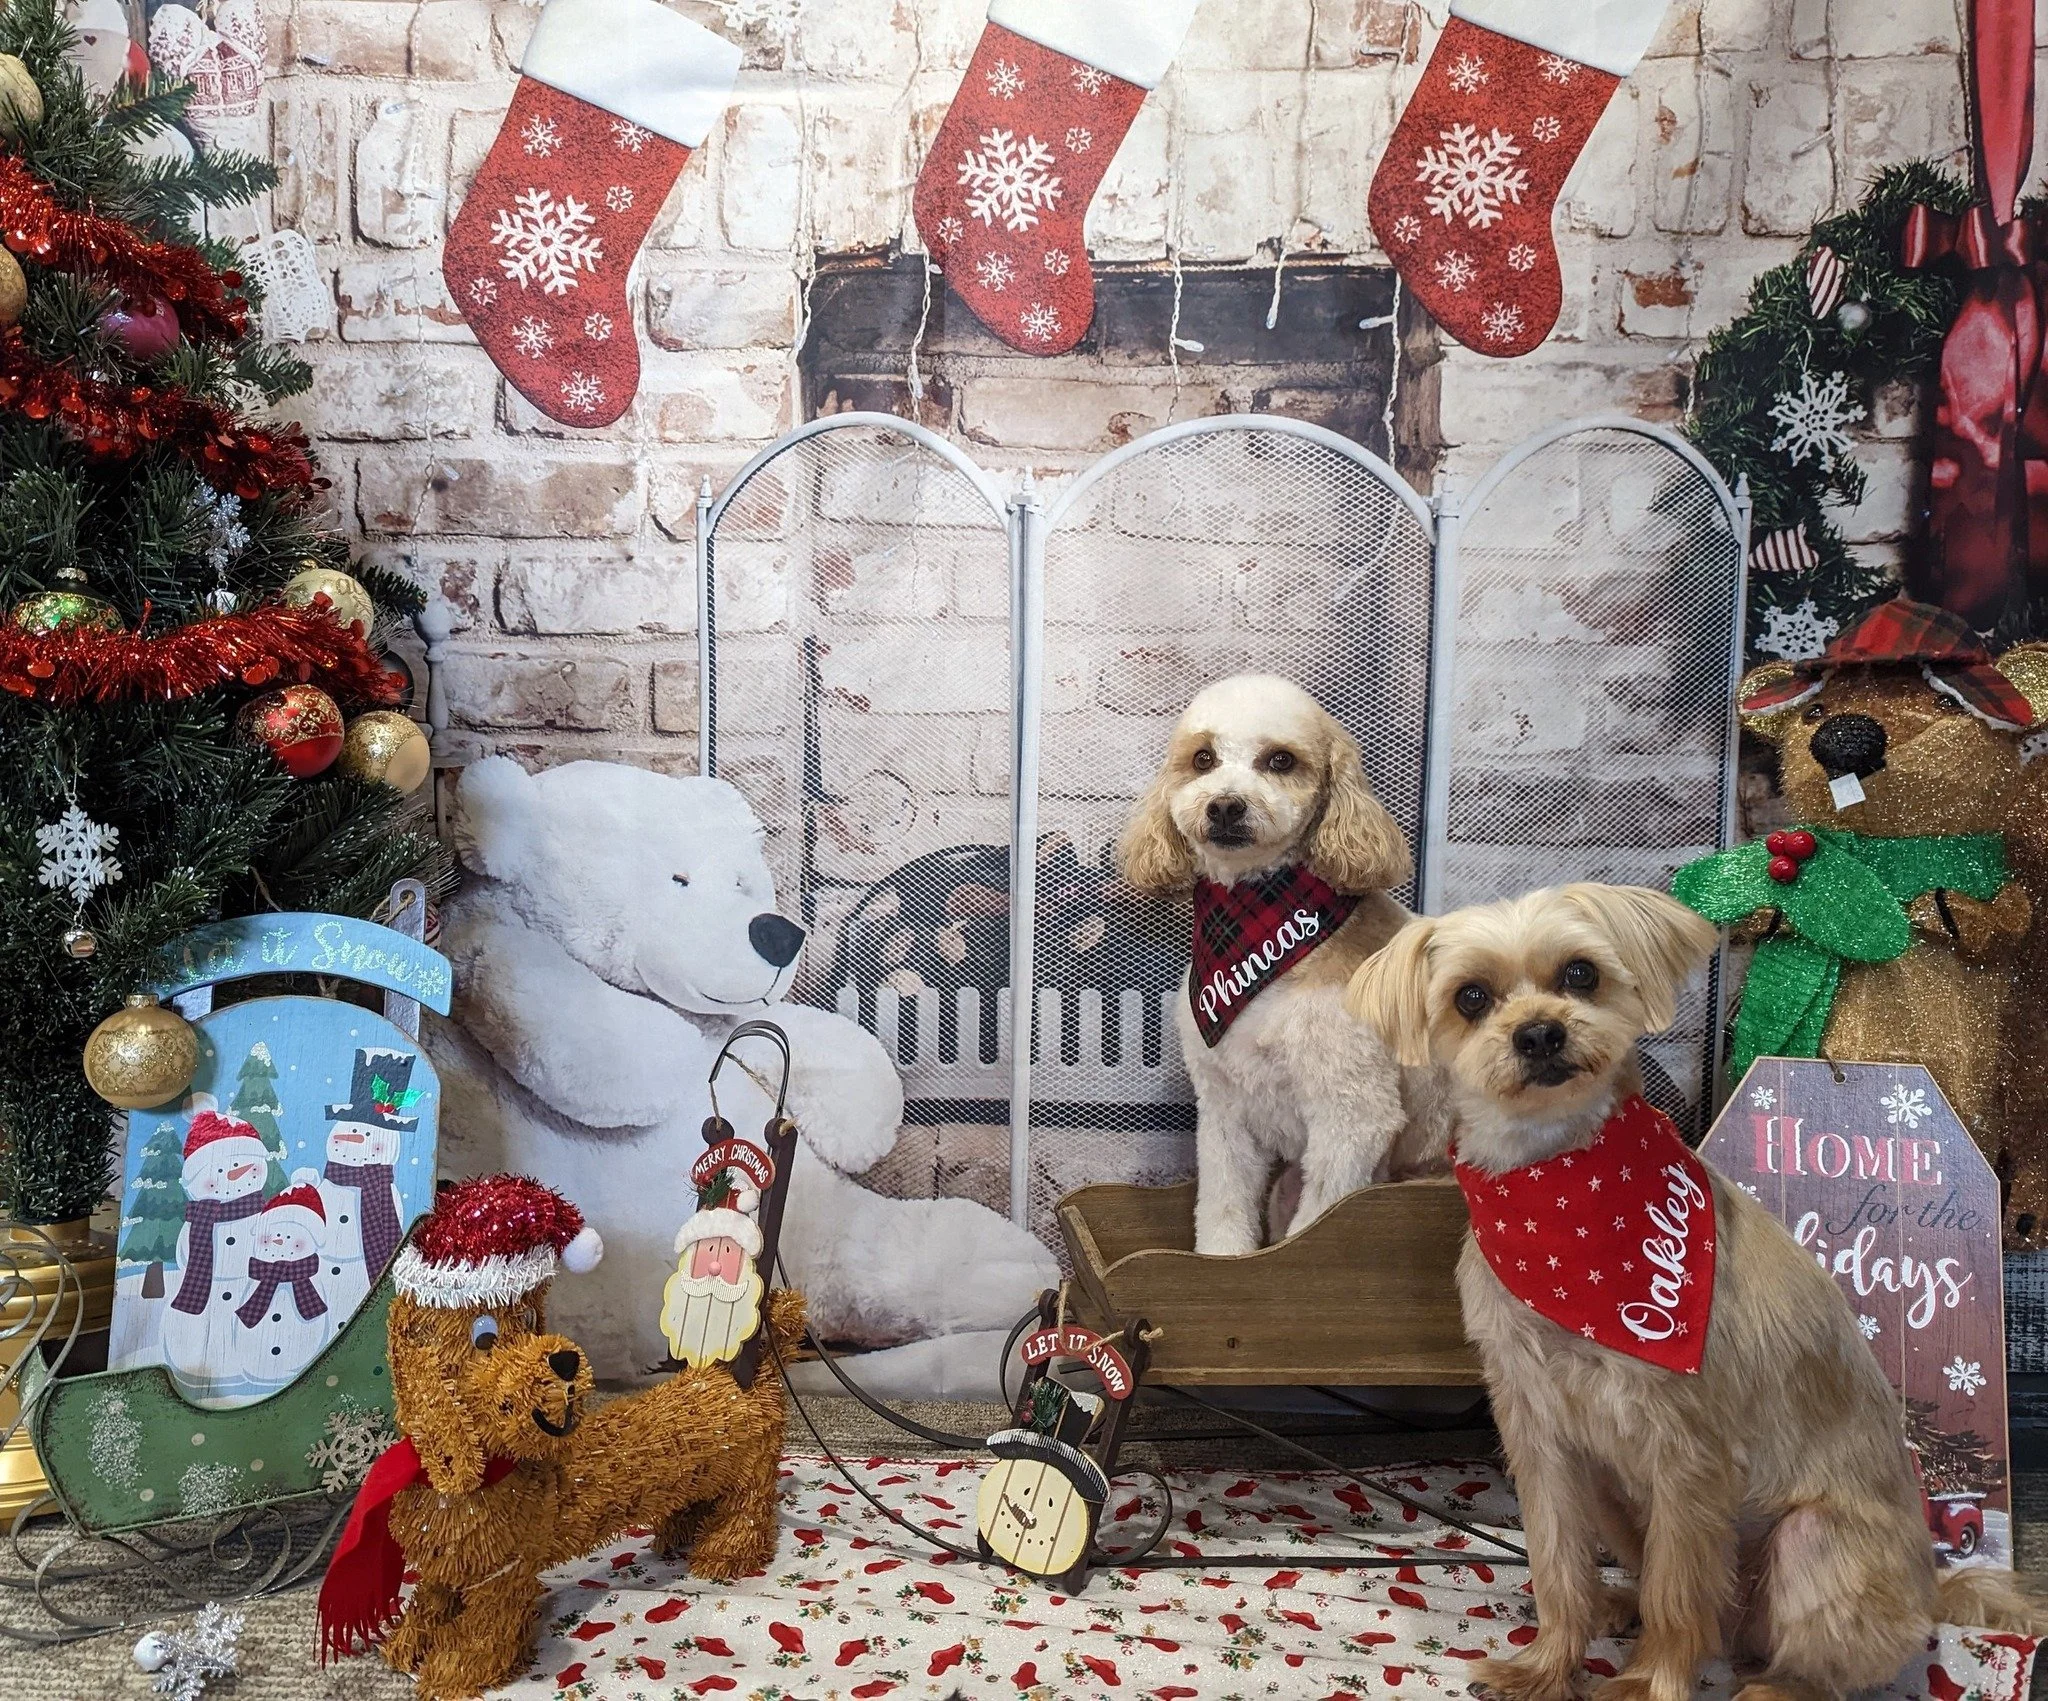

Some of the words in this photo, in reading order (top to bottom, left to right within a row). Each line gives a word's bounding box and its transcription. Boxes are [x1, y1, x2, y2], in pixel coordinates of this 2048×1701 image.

[261, 926, 299, 966] it
[312, 920, 418, 983] Snow
[1199, 908, 1320, 1024] Phineas
[695, 1146, 726, 1178] MERRY
[731, 1144, 768, 1184] CHRISTMAS
[1824, 1183, 1915, 1236] for
[1917, 1189, 1983, 1232] the
[1620, 1162, 1706, 1341] Oakley
[1794, 1211, 1973, 1330] lidays
[1025, 1333, 1059, 1360] LET
[1069, 1334, 1088, 1350] IT
[1087, 1345, 1126, 1392] SNOW
